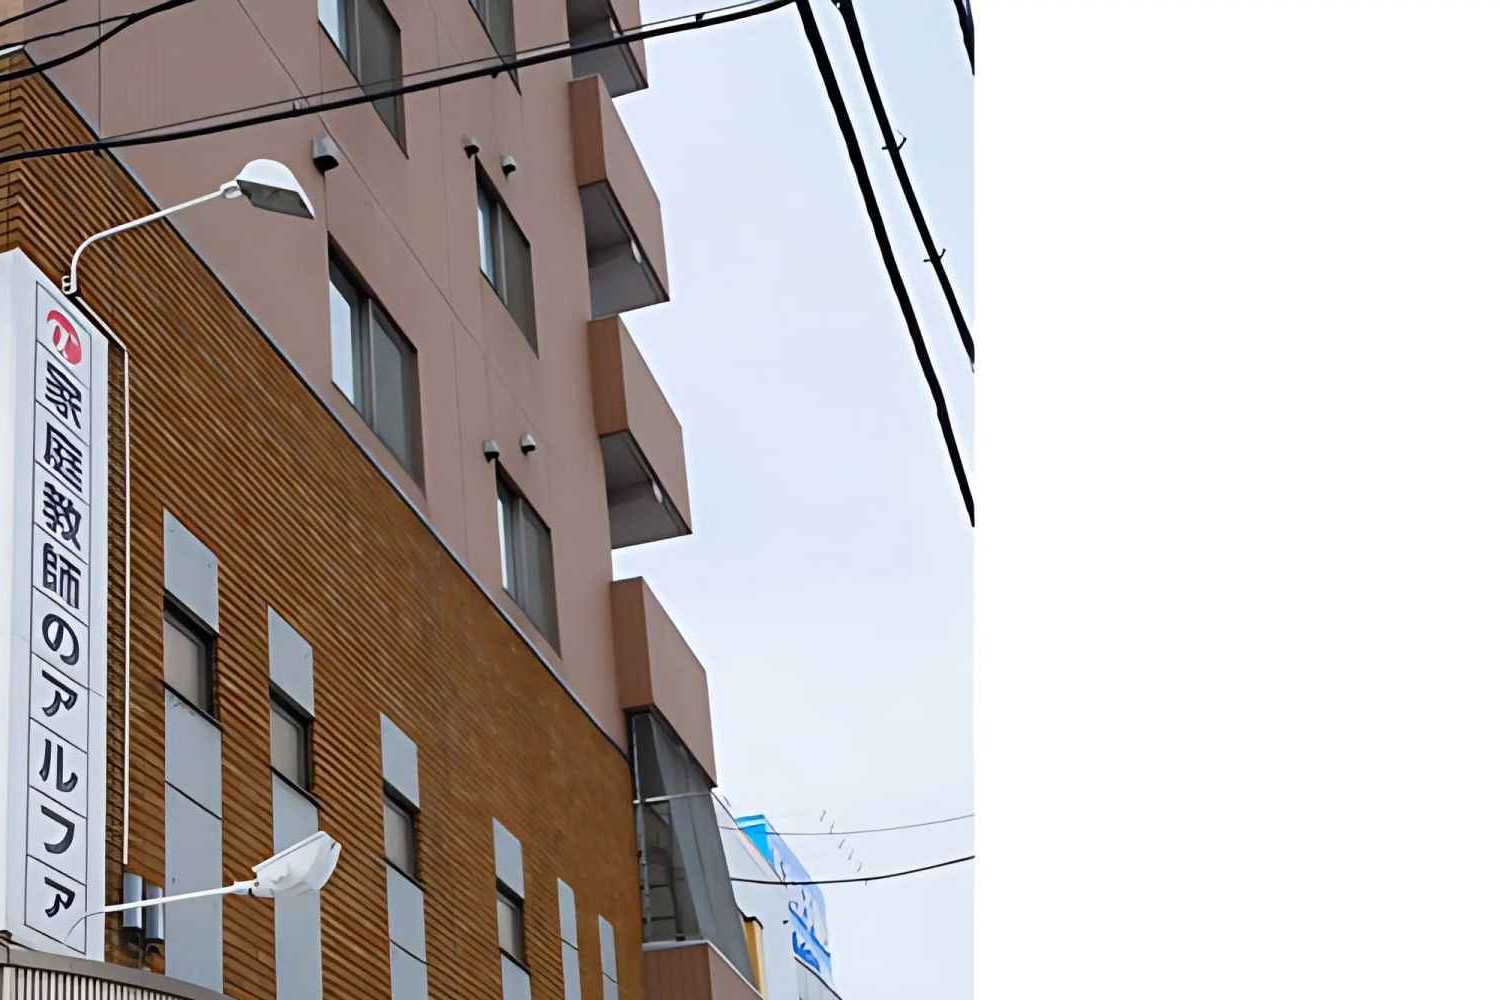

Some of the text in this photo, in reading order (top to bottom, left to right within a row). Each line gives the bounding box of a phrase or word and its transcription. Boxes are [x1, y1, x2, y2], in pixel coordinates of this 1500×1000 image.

[40, 360, 83, 918] 家庭教師のアルファ
